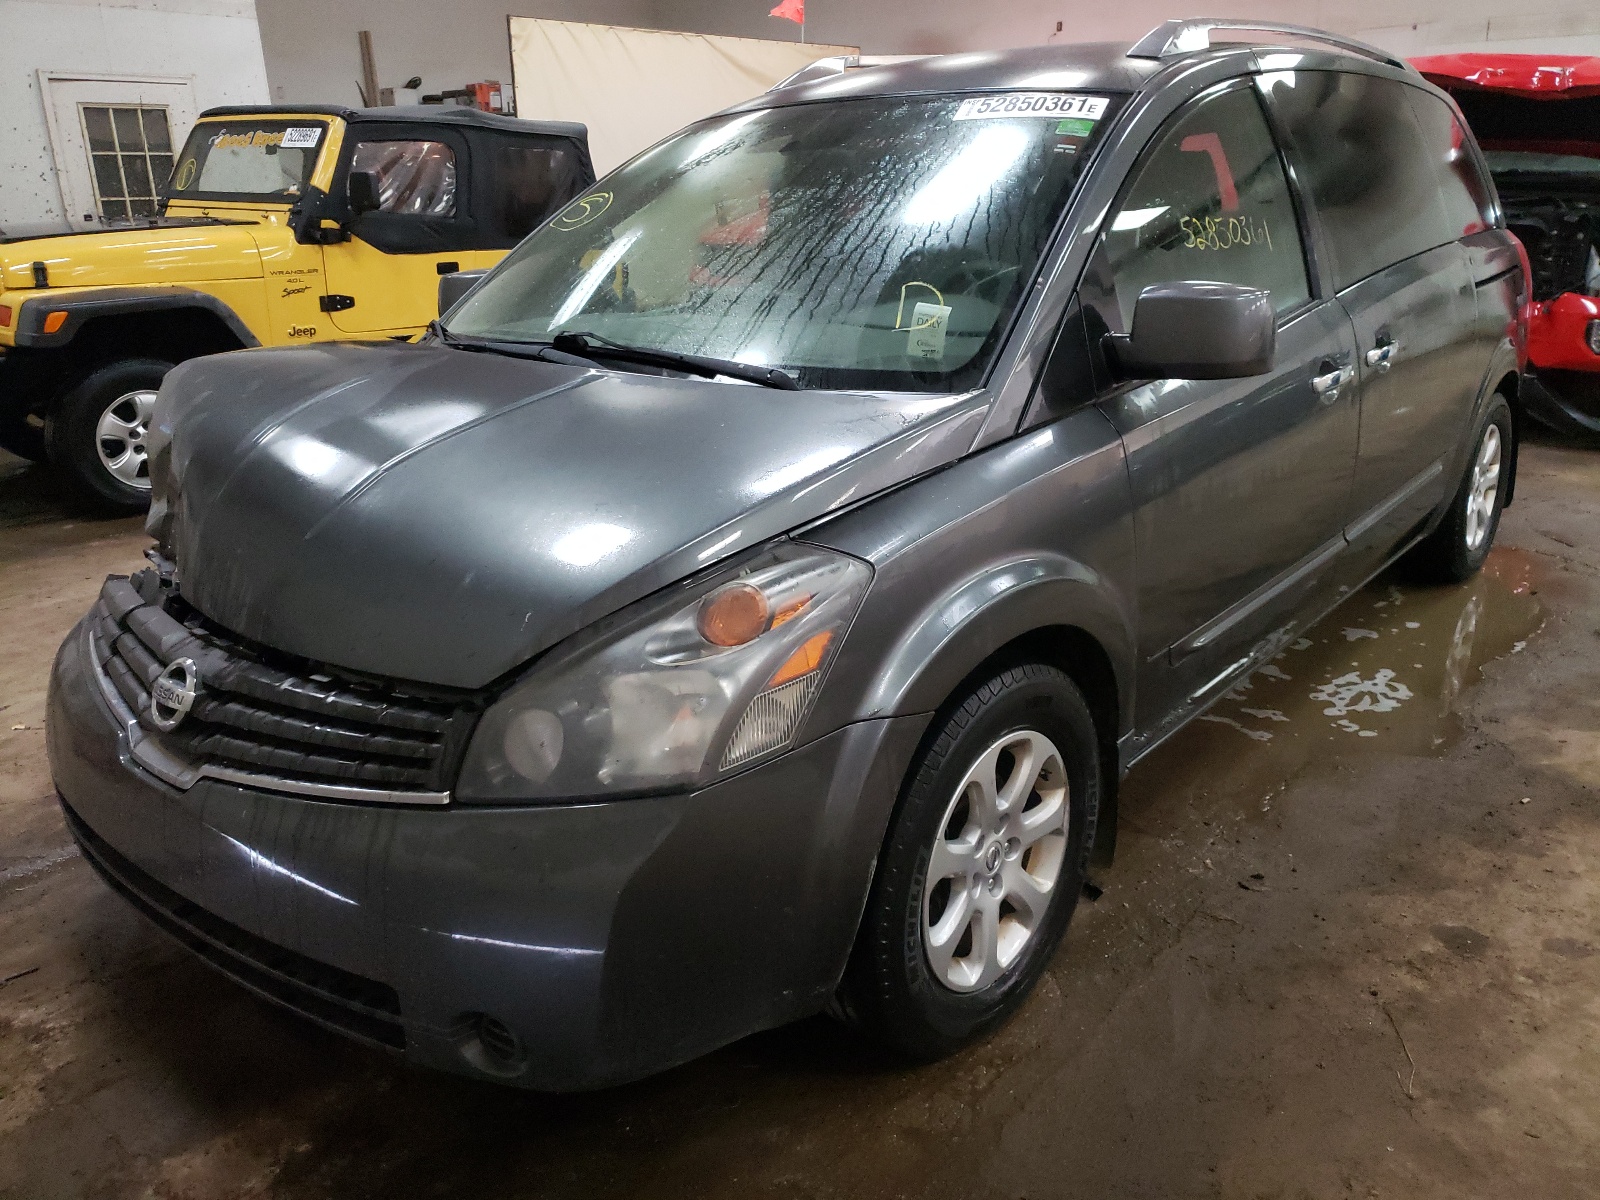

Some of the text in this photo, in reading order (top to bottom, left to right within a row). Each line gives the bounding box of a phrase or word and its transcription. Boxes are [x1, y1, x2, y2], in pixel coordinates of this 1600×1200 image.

[976, 96, 1089, 114] 52850361
[1087, 104, 1099, 113] E
[288, 326, 317, 338] Jeep
